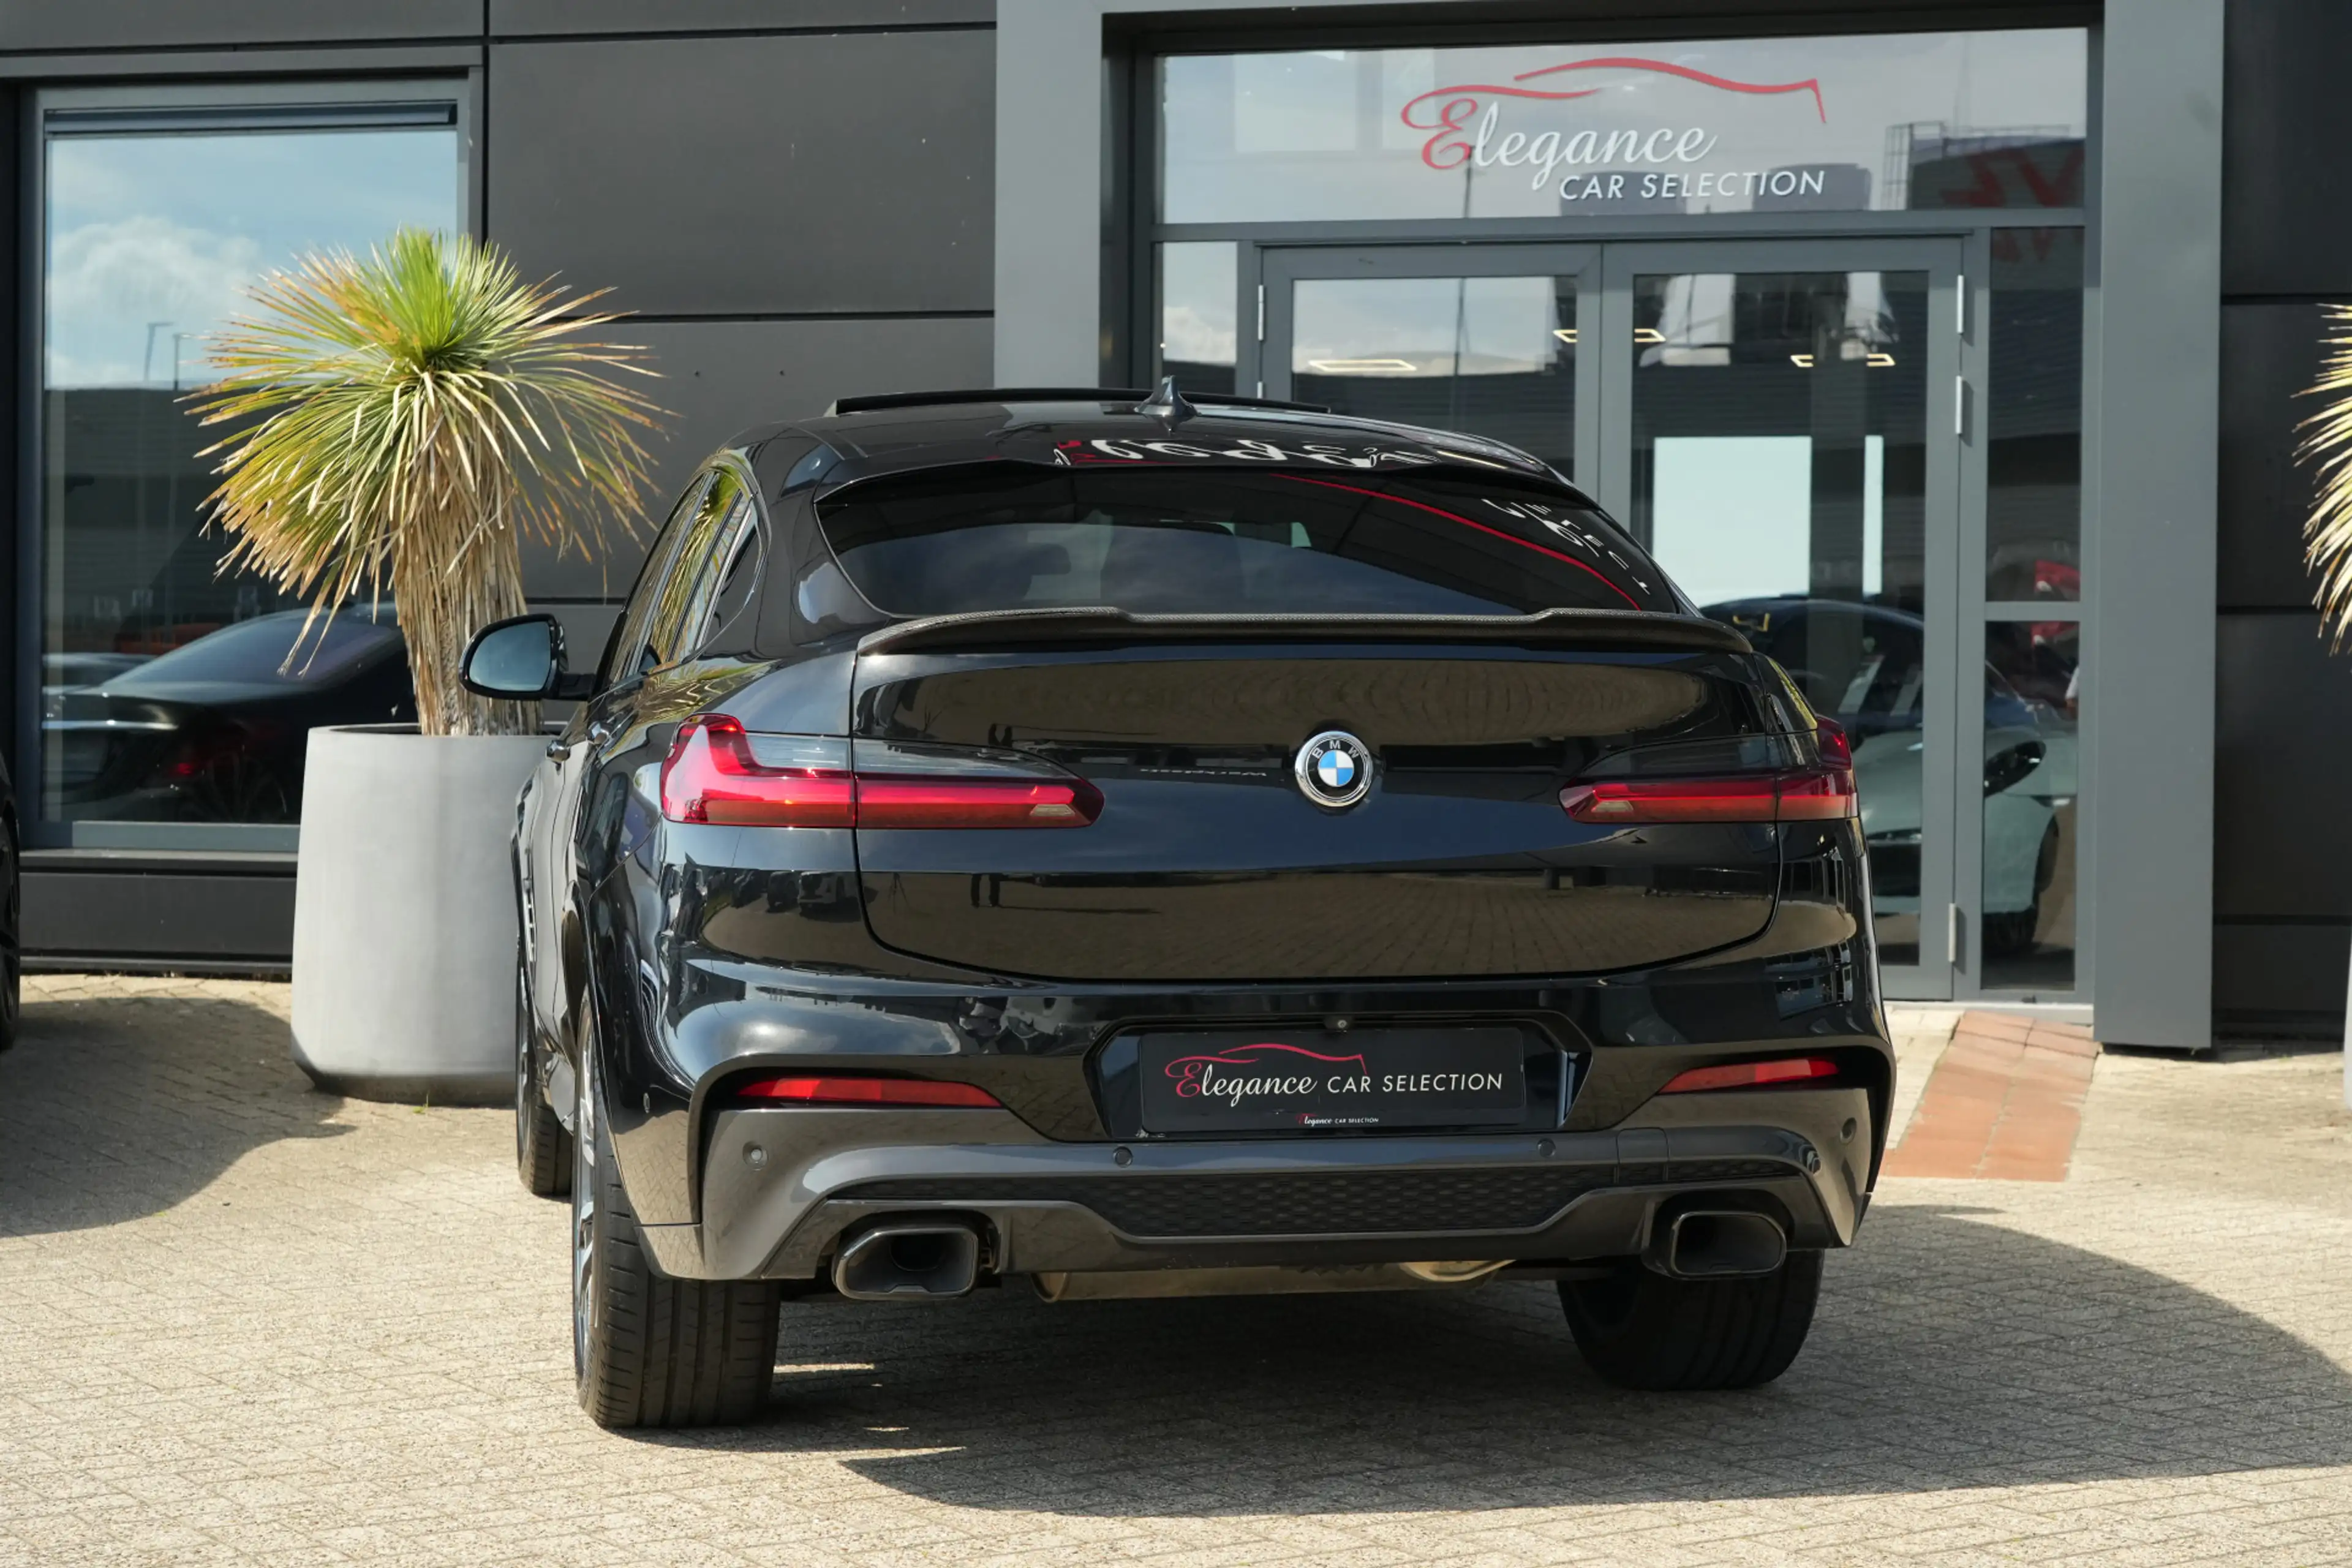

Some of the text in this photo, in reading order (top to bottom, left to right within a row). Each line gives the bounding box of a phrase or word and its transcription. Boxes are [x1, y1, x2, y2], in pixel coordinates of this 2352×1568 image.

[1401, 84, 1718, 190] Elegance
[1559, 170, 1826, 200] CAR SELECTION
[1312, 740, 1359, 760] BMW
[1165, 1055, 1502, 1107] Elegance CAR SELECTION
